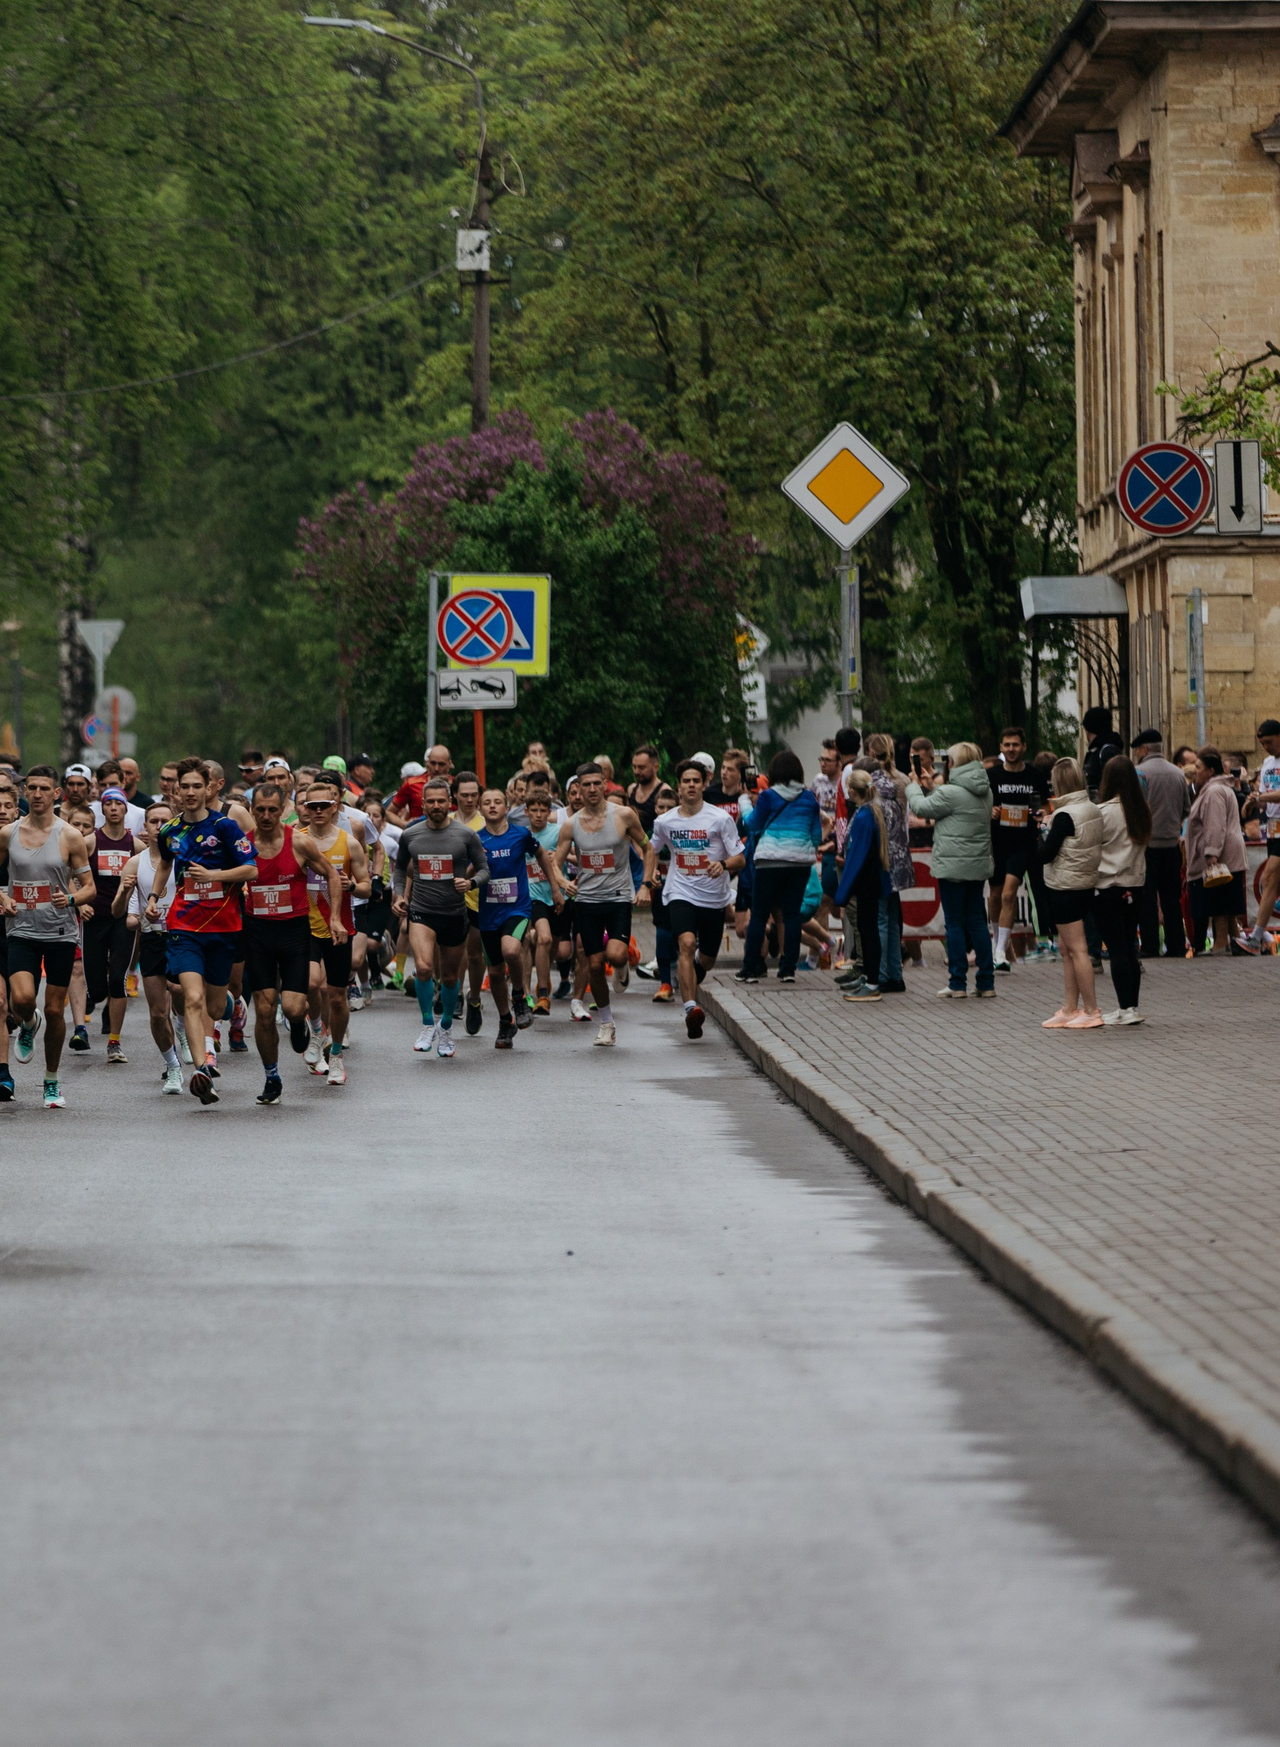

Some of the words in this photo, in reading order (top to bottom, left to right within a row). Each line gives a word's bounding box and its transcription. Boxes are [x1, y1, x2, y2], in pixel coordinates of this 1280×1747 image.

[108, 856, 123, 867] 904
[429, 860, 442, 871] 761
[589, 855, 605, 866] 660
[684, 855, 700, 866] 1056
[22, 887, 39, 899] 624
[491, 883, 511, 895] 2039
[263, 891, 279, 904] 707
